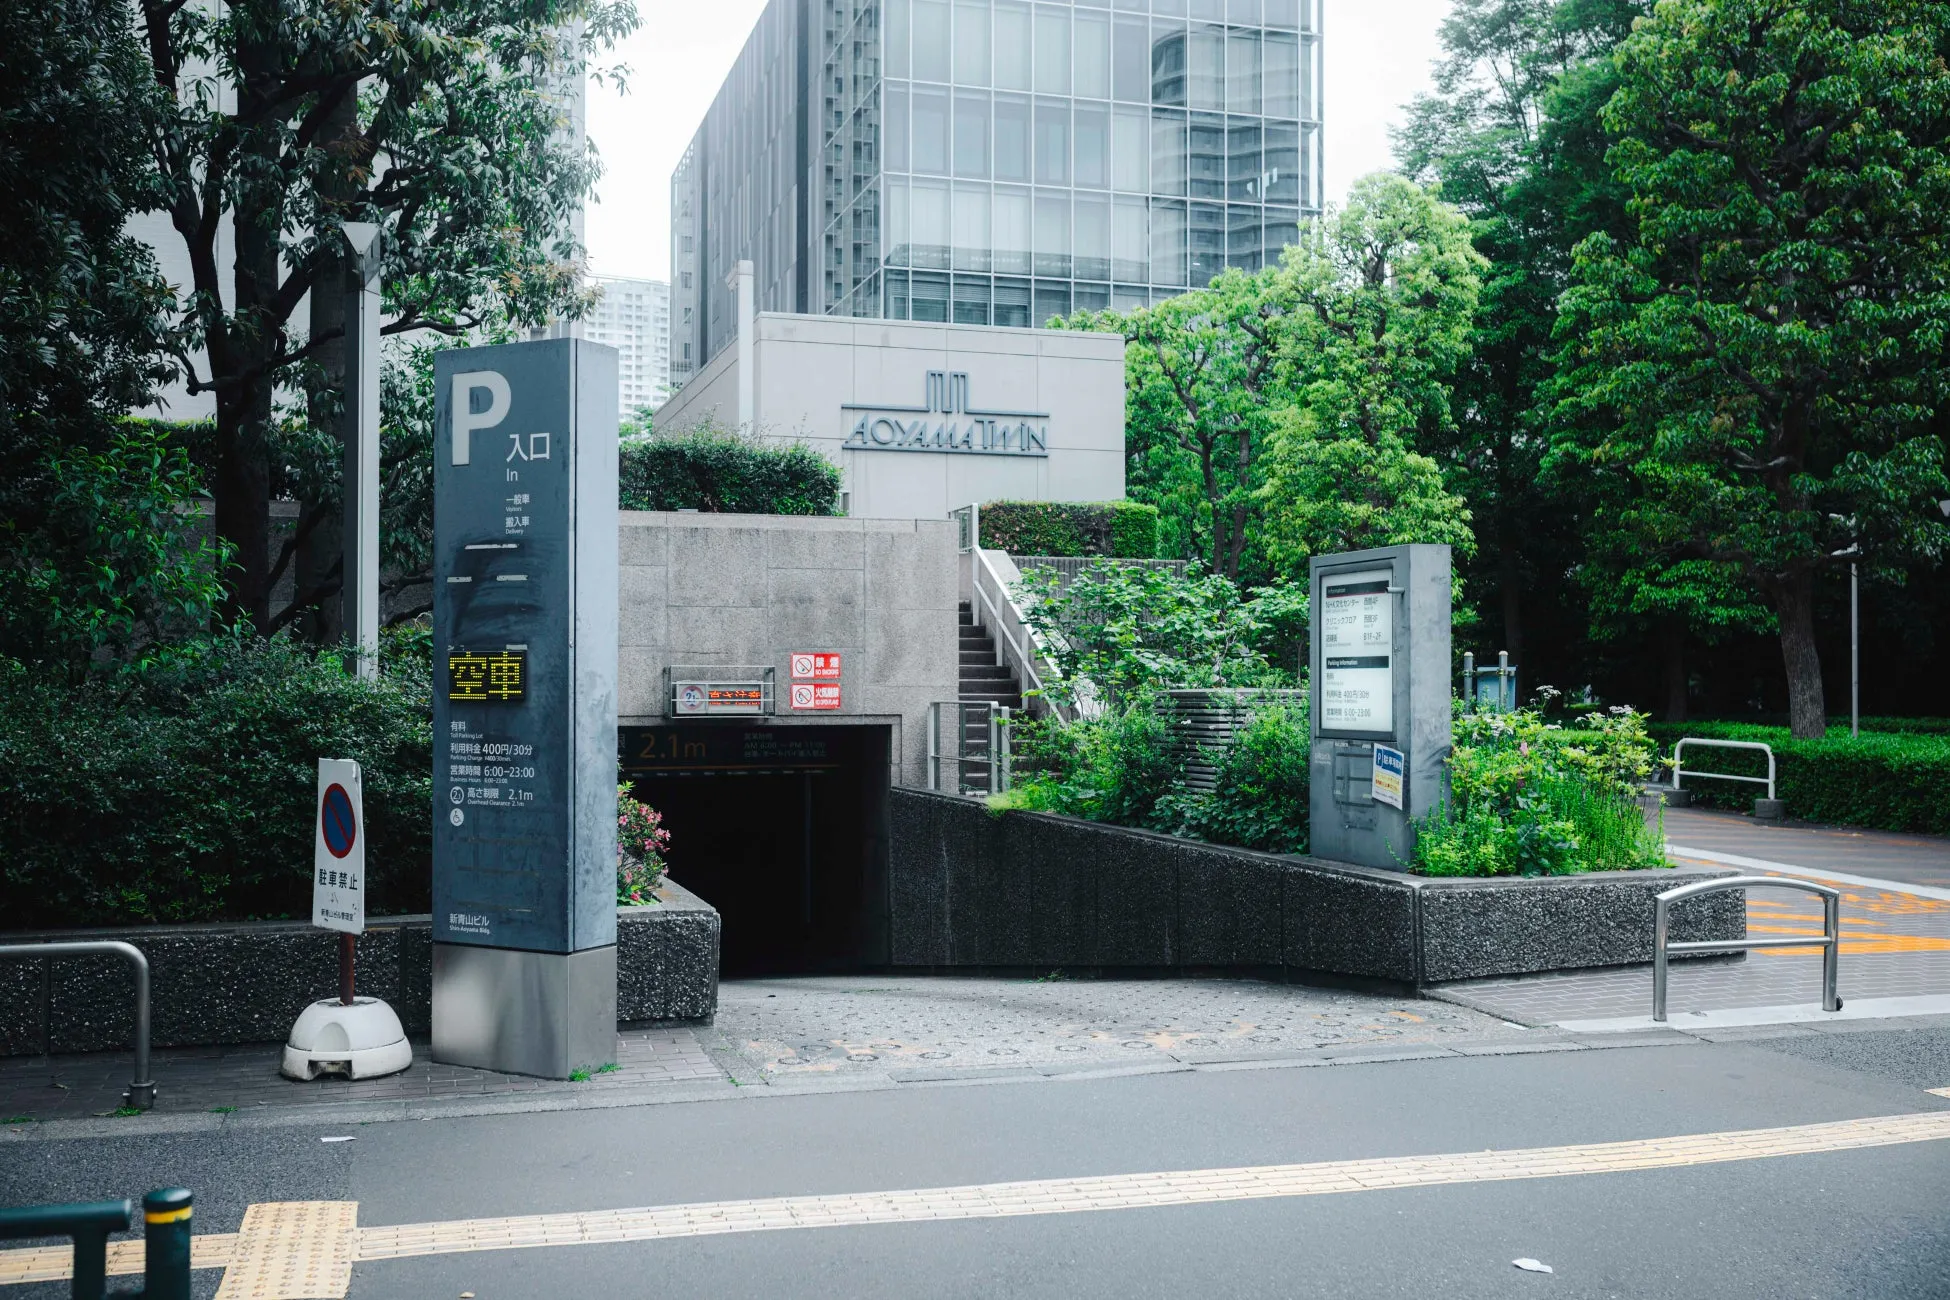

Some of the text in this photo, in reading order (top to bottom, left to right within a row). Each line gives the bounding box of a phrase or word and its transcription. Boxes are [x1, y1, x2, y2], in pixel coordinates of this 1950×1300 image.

[452, 370, 512, 466] P
[506, 432, 550, 462] 入口
[506, 468, 518, 482] In
[505, 493, 530, 505] 一般車
[449, 651, 523, 700] 空車
[450, 720, 466, 732] 有料
[450, 743, 533, 756] 利用料金 400円/30分
[639, 732, 706, 758] 2.1m
[450, 765, 481, 776] 営業時間
[467, 787, 533, 801] 高さ制限 2.1m
[319, 868, 358, 891] 駐車禁止
[449, 913, 490, 926] 新青山ビル
